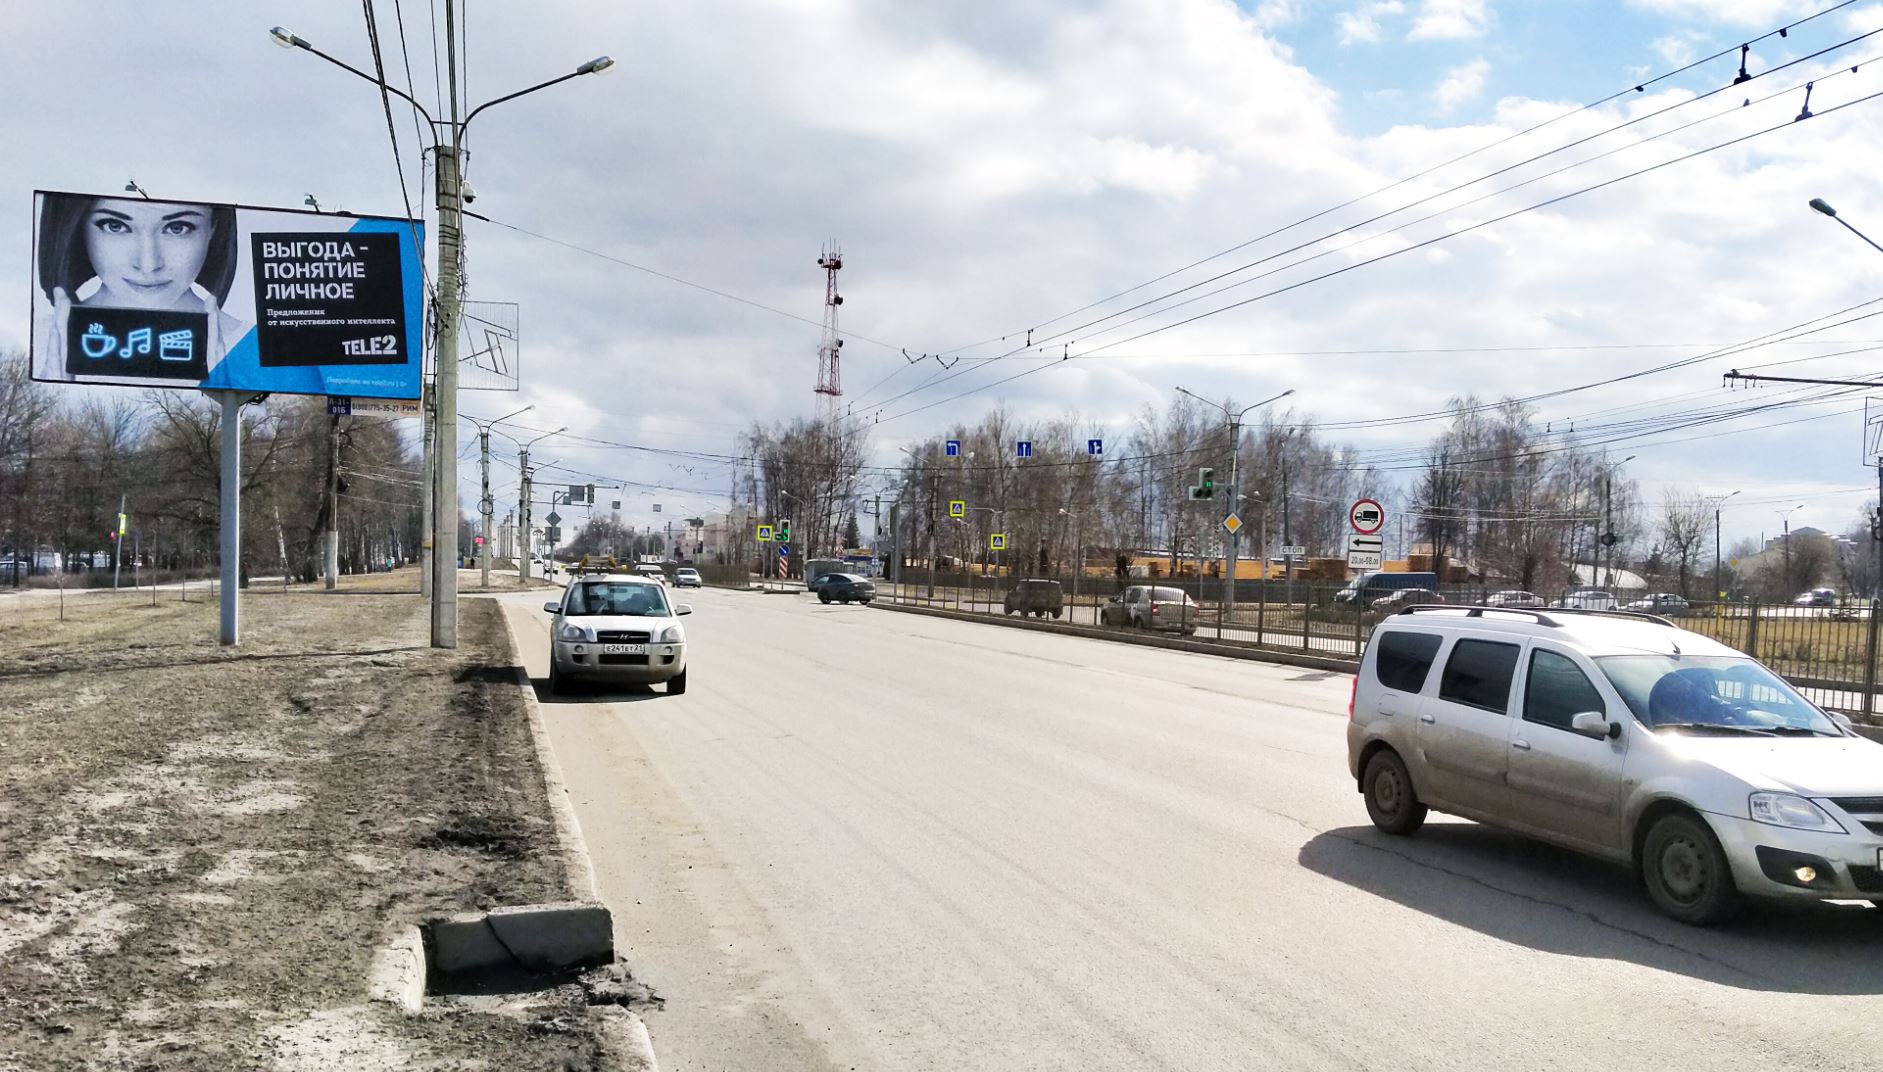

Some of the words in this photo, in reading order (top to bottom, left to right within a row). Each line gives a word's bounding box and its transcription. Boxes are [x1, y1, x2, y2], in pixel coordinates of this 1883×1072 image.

[262, 241, 355, 261] ВЫГОДА
[264, 262, 366, 279] ПОНЯТИЕ
[265, 283, 355, 300] ЛИЧНОЕ
[266, 308, 325, 317] Предложения
[279, 319, 345, 327] искусственного
[341, 334, 398, 356] TELE2
[1282, 546, 1303, 554] СТОП
